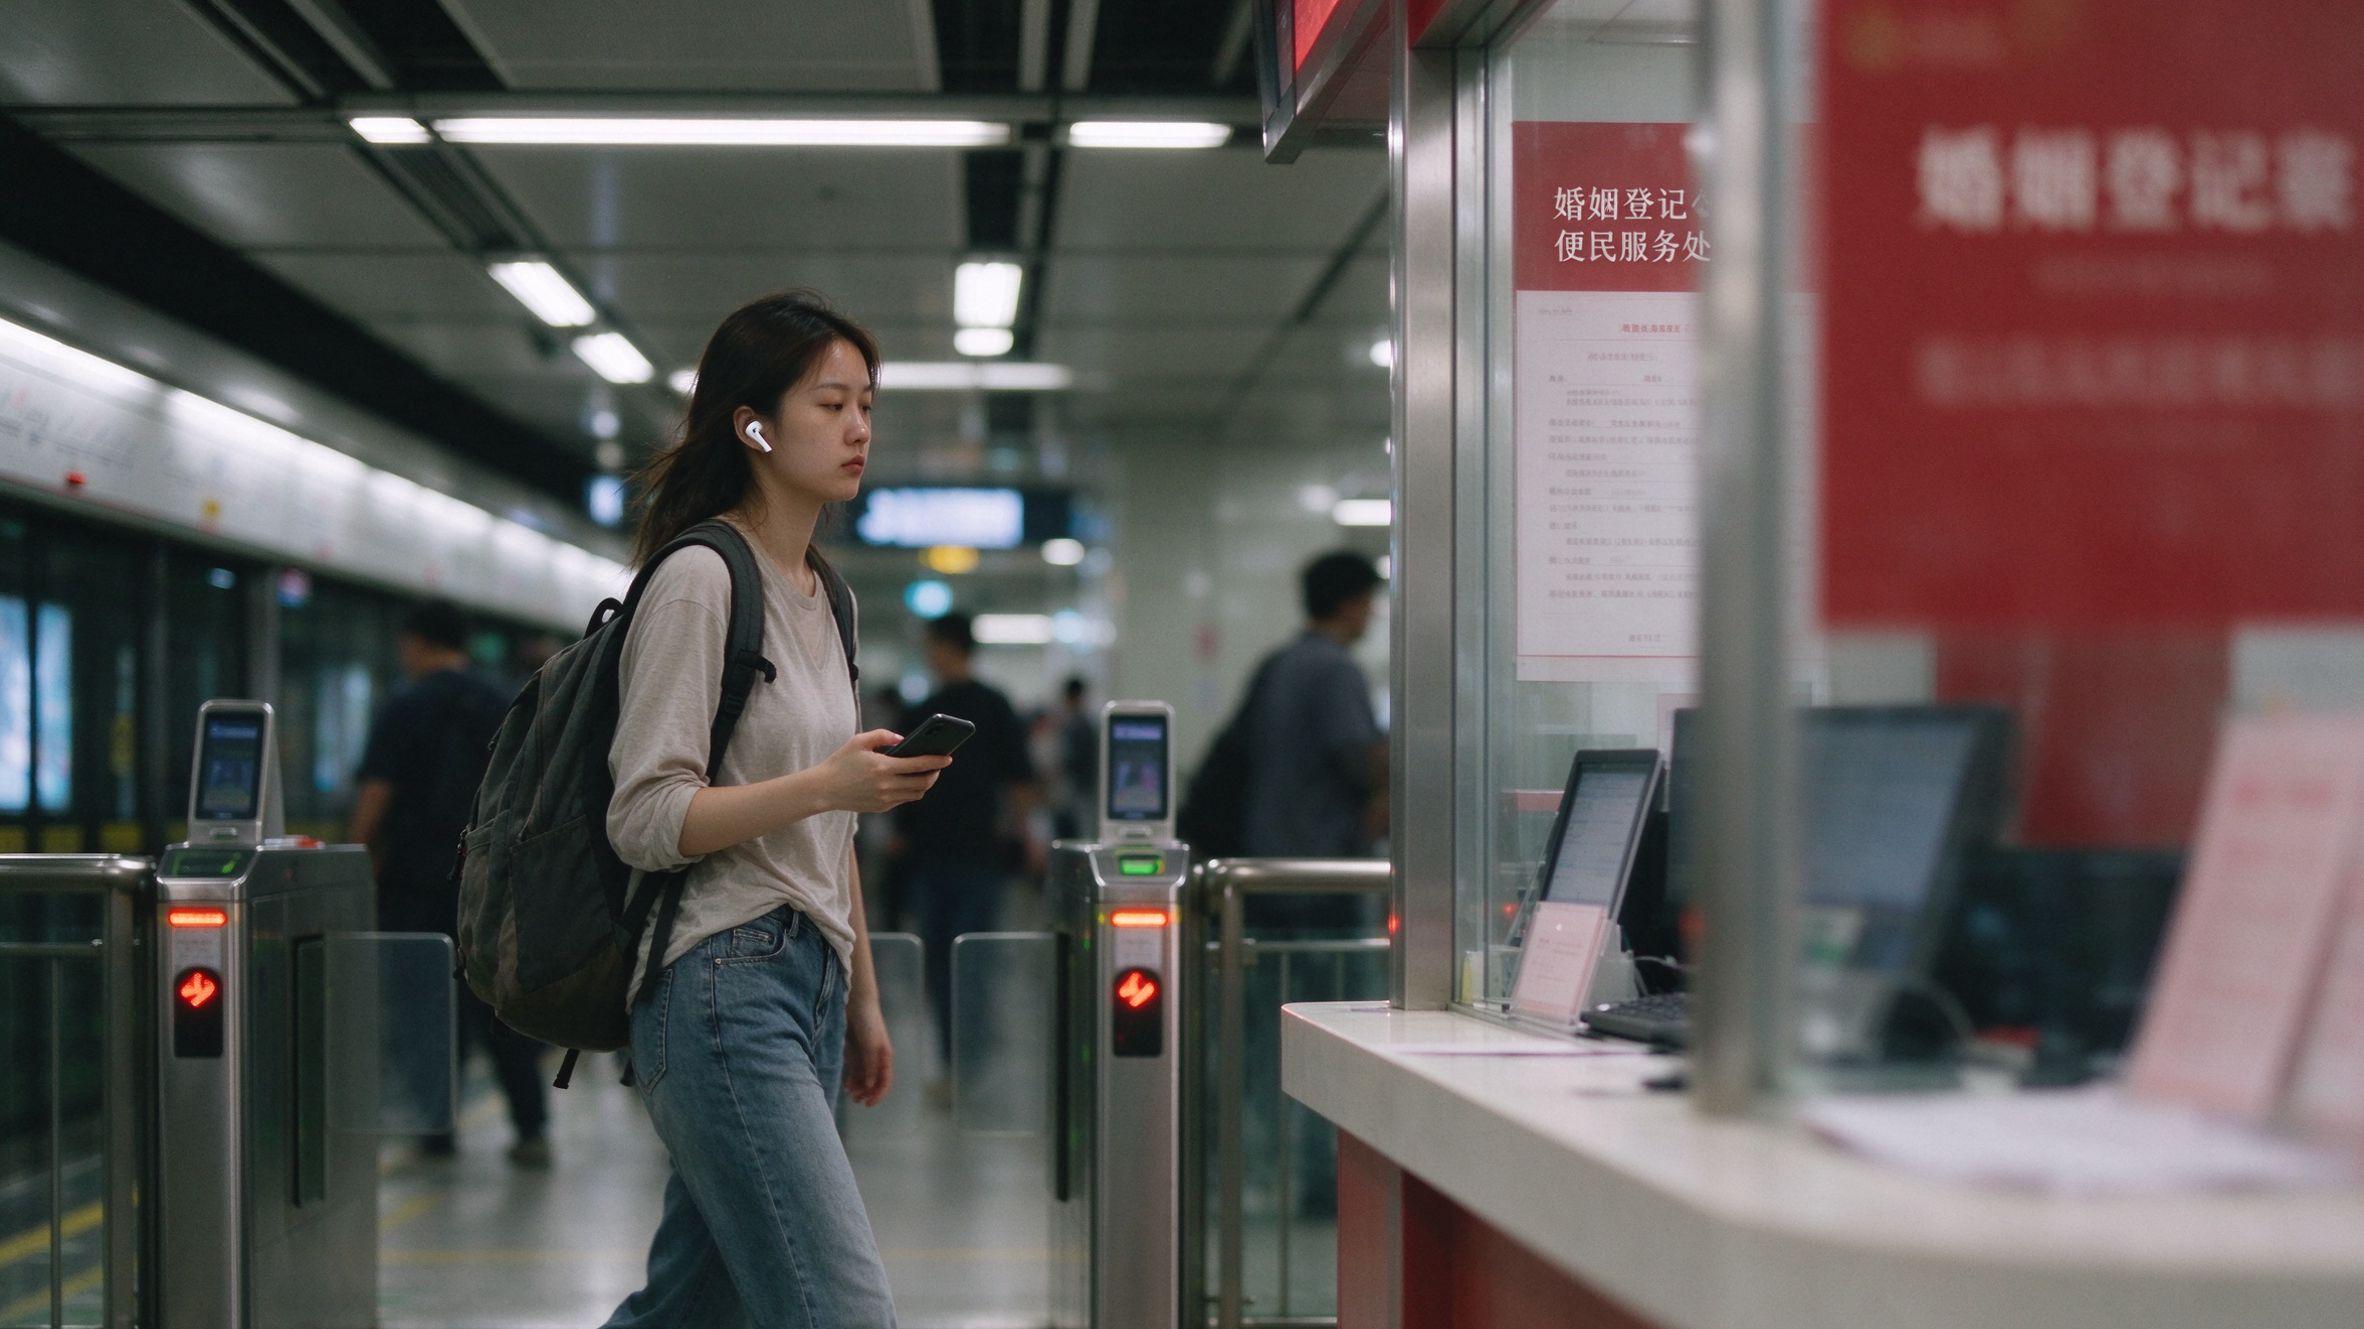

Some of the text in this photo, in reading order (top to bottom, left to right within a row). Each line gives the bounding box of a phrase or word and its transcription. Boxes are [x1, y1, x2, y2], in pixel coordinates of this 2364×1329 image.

[1554, 229, 1711, 262] 便民服务处
